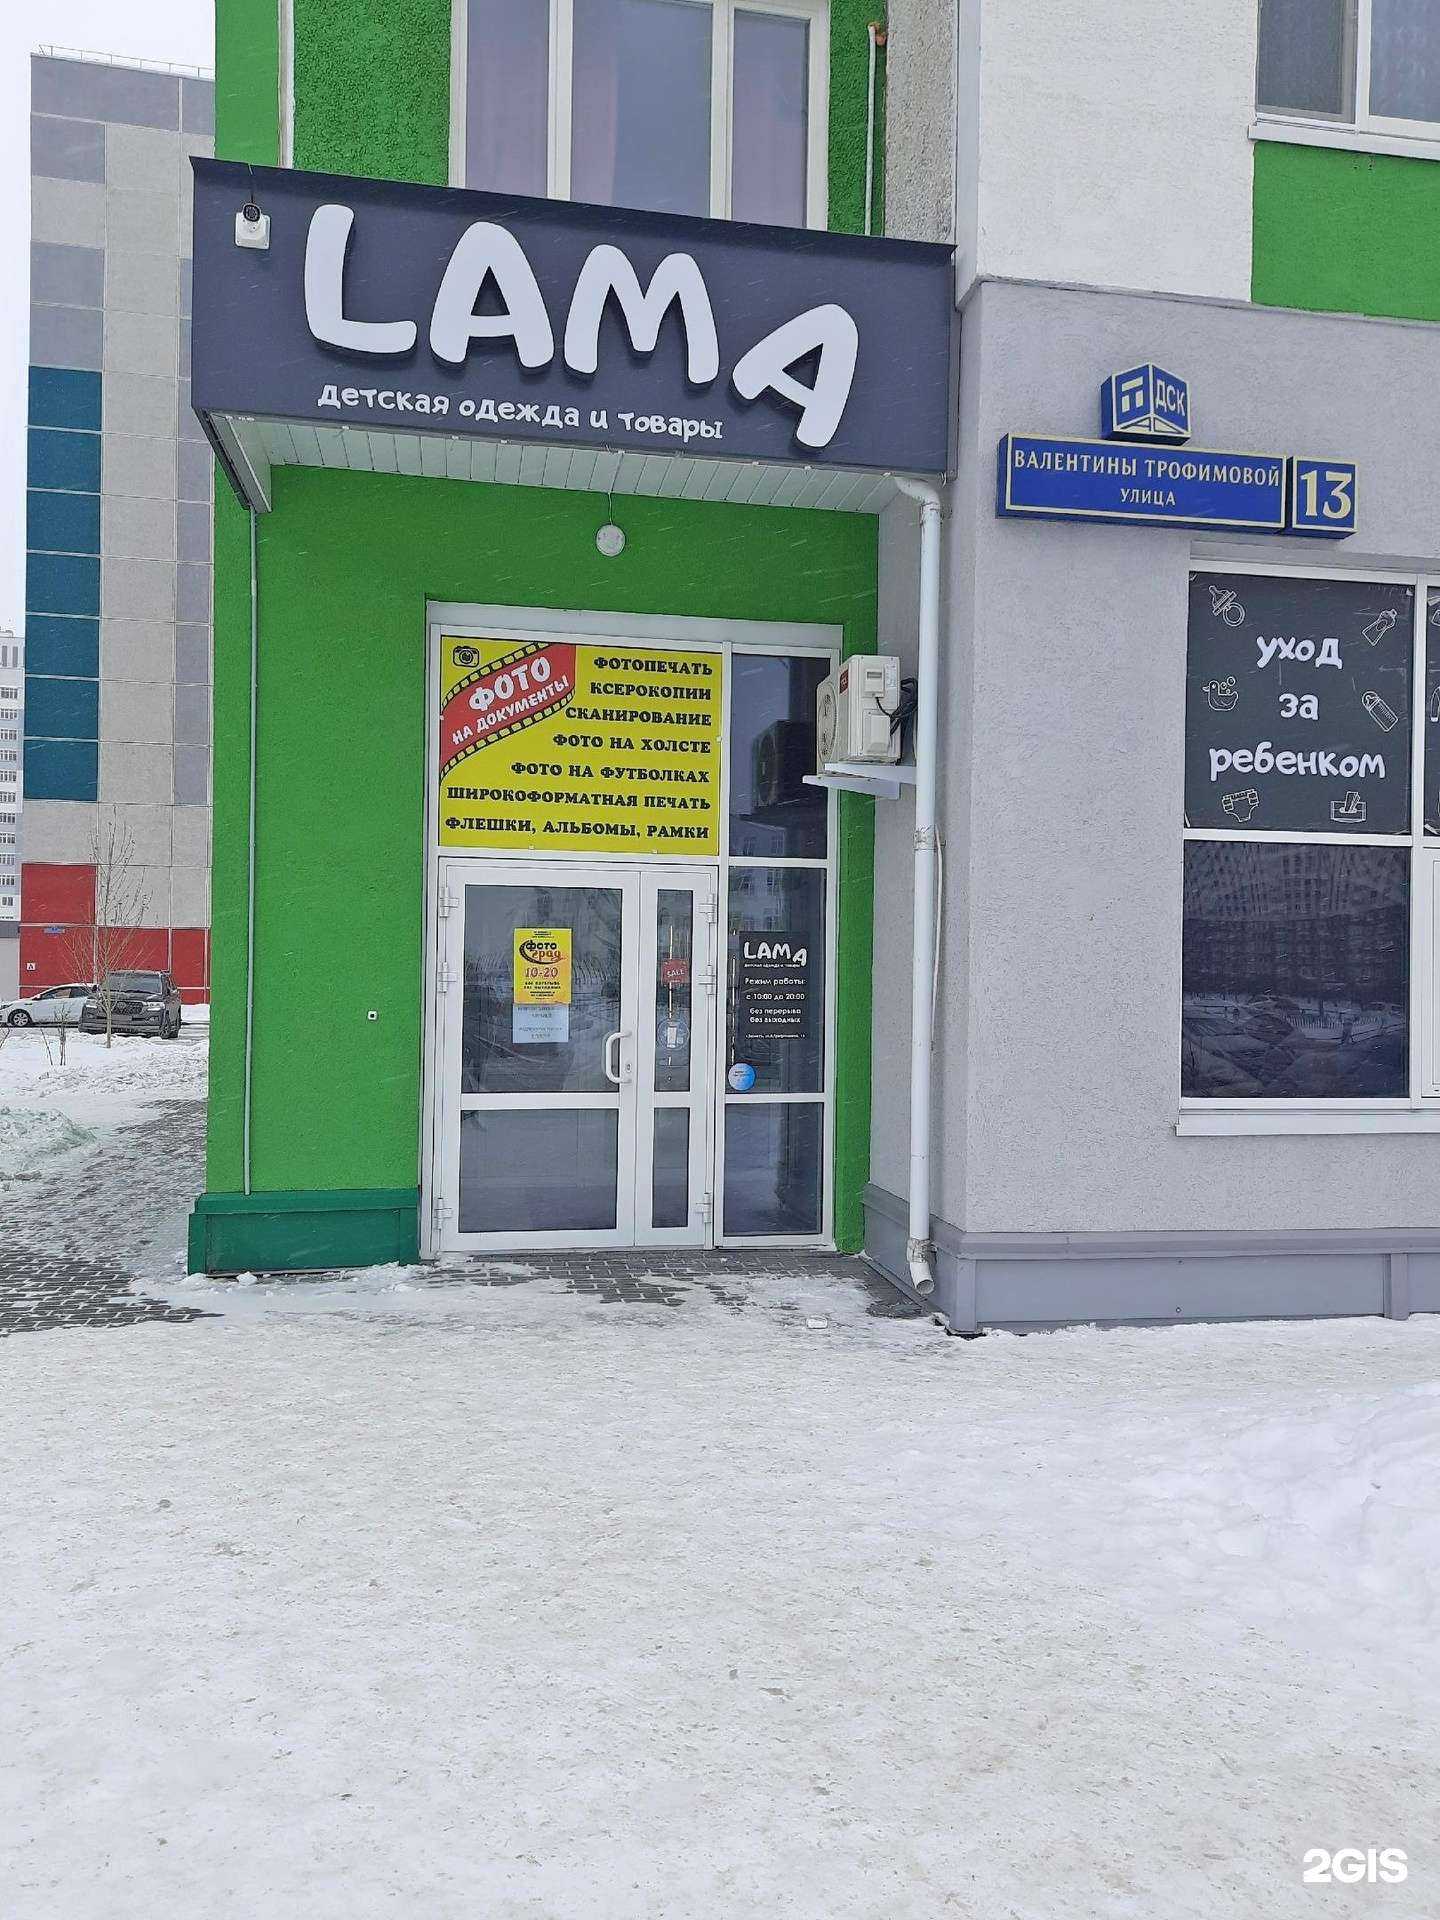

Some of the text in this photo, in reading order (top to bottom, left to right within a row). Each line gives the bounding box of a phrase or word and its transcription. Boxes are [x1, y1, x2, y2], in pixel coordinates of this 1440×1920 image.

[303, 203, 858, 448] LAMA
[317, 383, 724, 441] детская одежда и товары
[1155, 379, 1186, 417] ДСК
[1013, 449, 1280, 487] ВАЛЕНТИНЫ ТРОФИМОВОЙ
[1119, 488, 1176, 507] УЛИЦА
[1299, 470, 1353, 520] 13
[593, 657, 713, 676] ФОТОПЕЧАТЬ
[1256, 635, 1343, 670] уход
[468, 656, 552, 712] ФОТО
[590, 682, 712, 701] КСЕРОКОПИИ
[451, 675, 570, 746] НА ДОКУМЕНТЫ
[565, 707, 712, 726] СКАНИРОВАНИЕ
[1279, 693, 1320, 721] за
[552, 734, 712, 754] ФОТО НА ХОЛСТЕ
[510, 762, 710, 784] ФОТО НА ФУТБОЛКАХ
[1209, 741, 1386, 782] ребенком
[446, 787, 712, 810] ШИРОКОФОРМАТНАЯ ПЕЧАТЬ
[445, 817, 710, 839] ФЛЕШКИ, АЛЬБОМЫ, РАМКИ
[743, 941, 807, 967] LAMA
